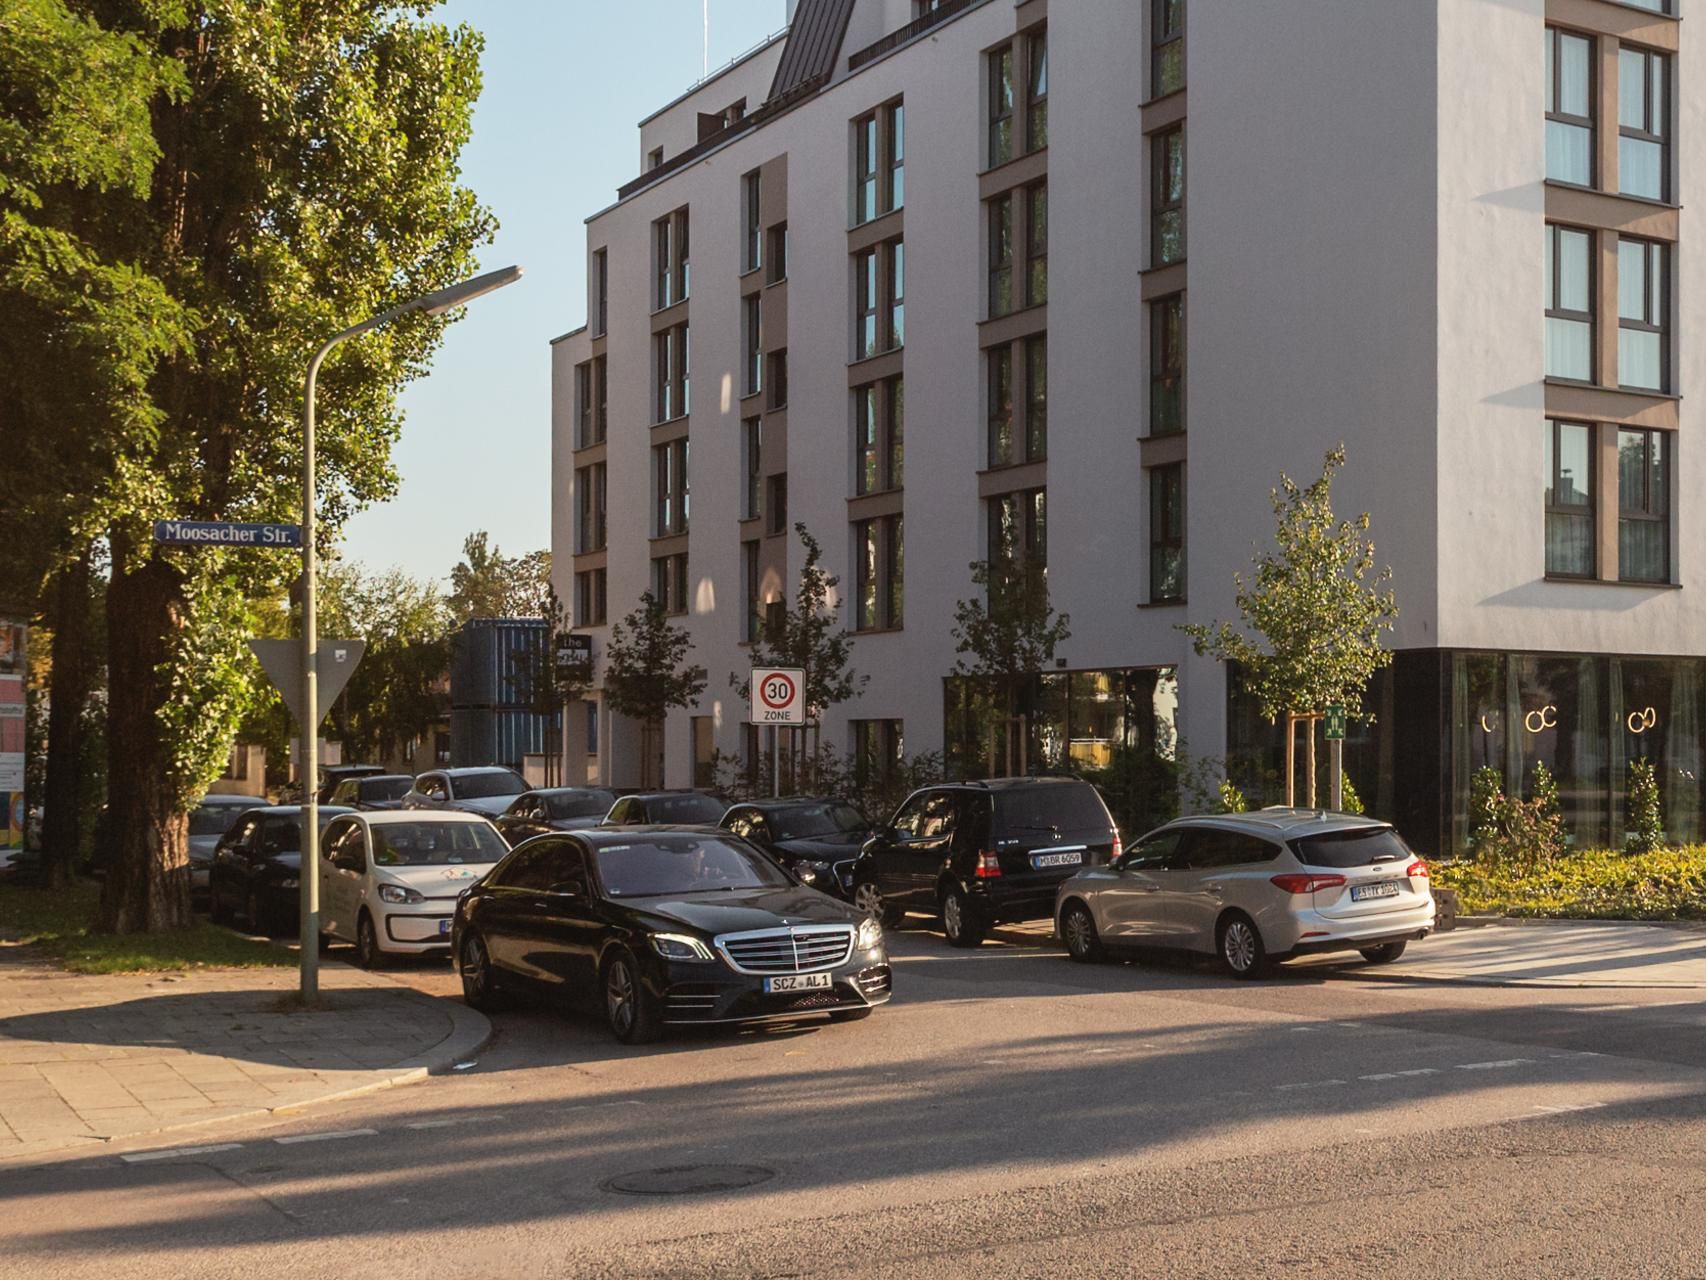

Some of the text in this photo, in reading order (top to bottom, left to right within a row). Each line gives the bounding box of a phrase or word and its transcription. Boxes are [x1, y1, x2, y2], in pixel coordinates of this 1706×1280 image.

[165, 523, 292, 543] Moosacher Str.
[767, 682, 788, 699] 30
[764, 710, 791, 721] ZONE
[773, 977, 796, 991] SCZ
